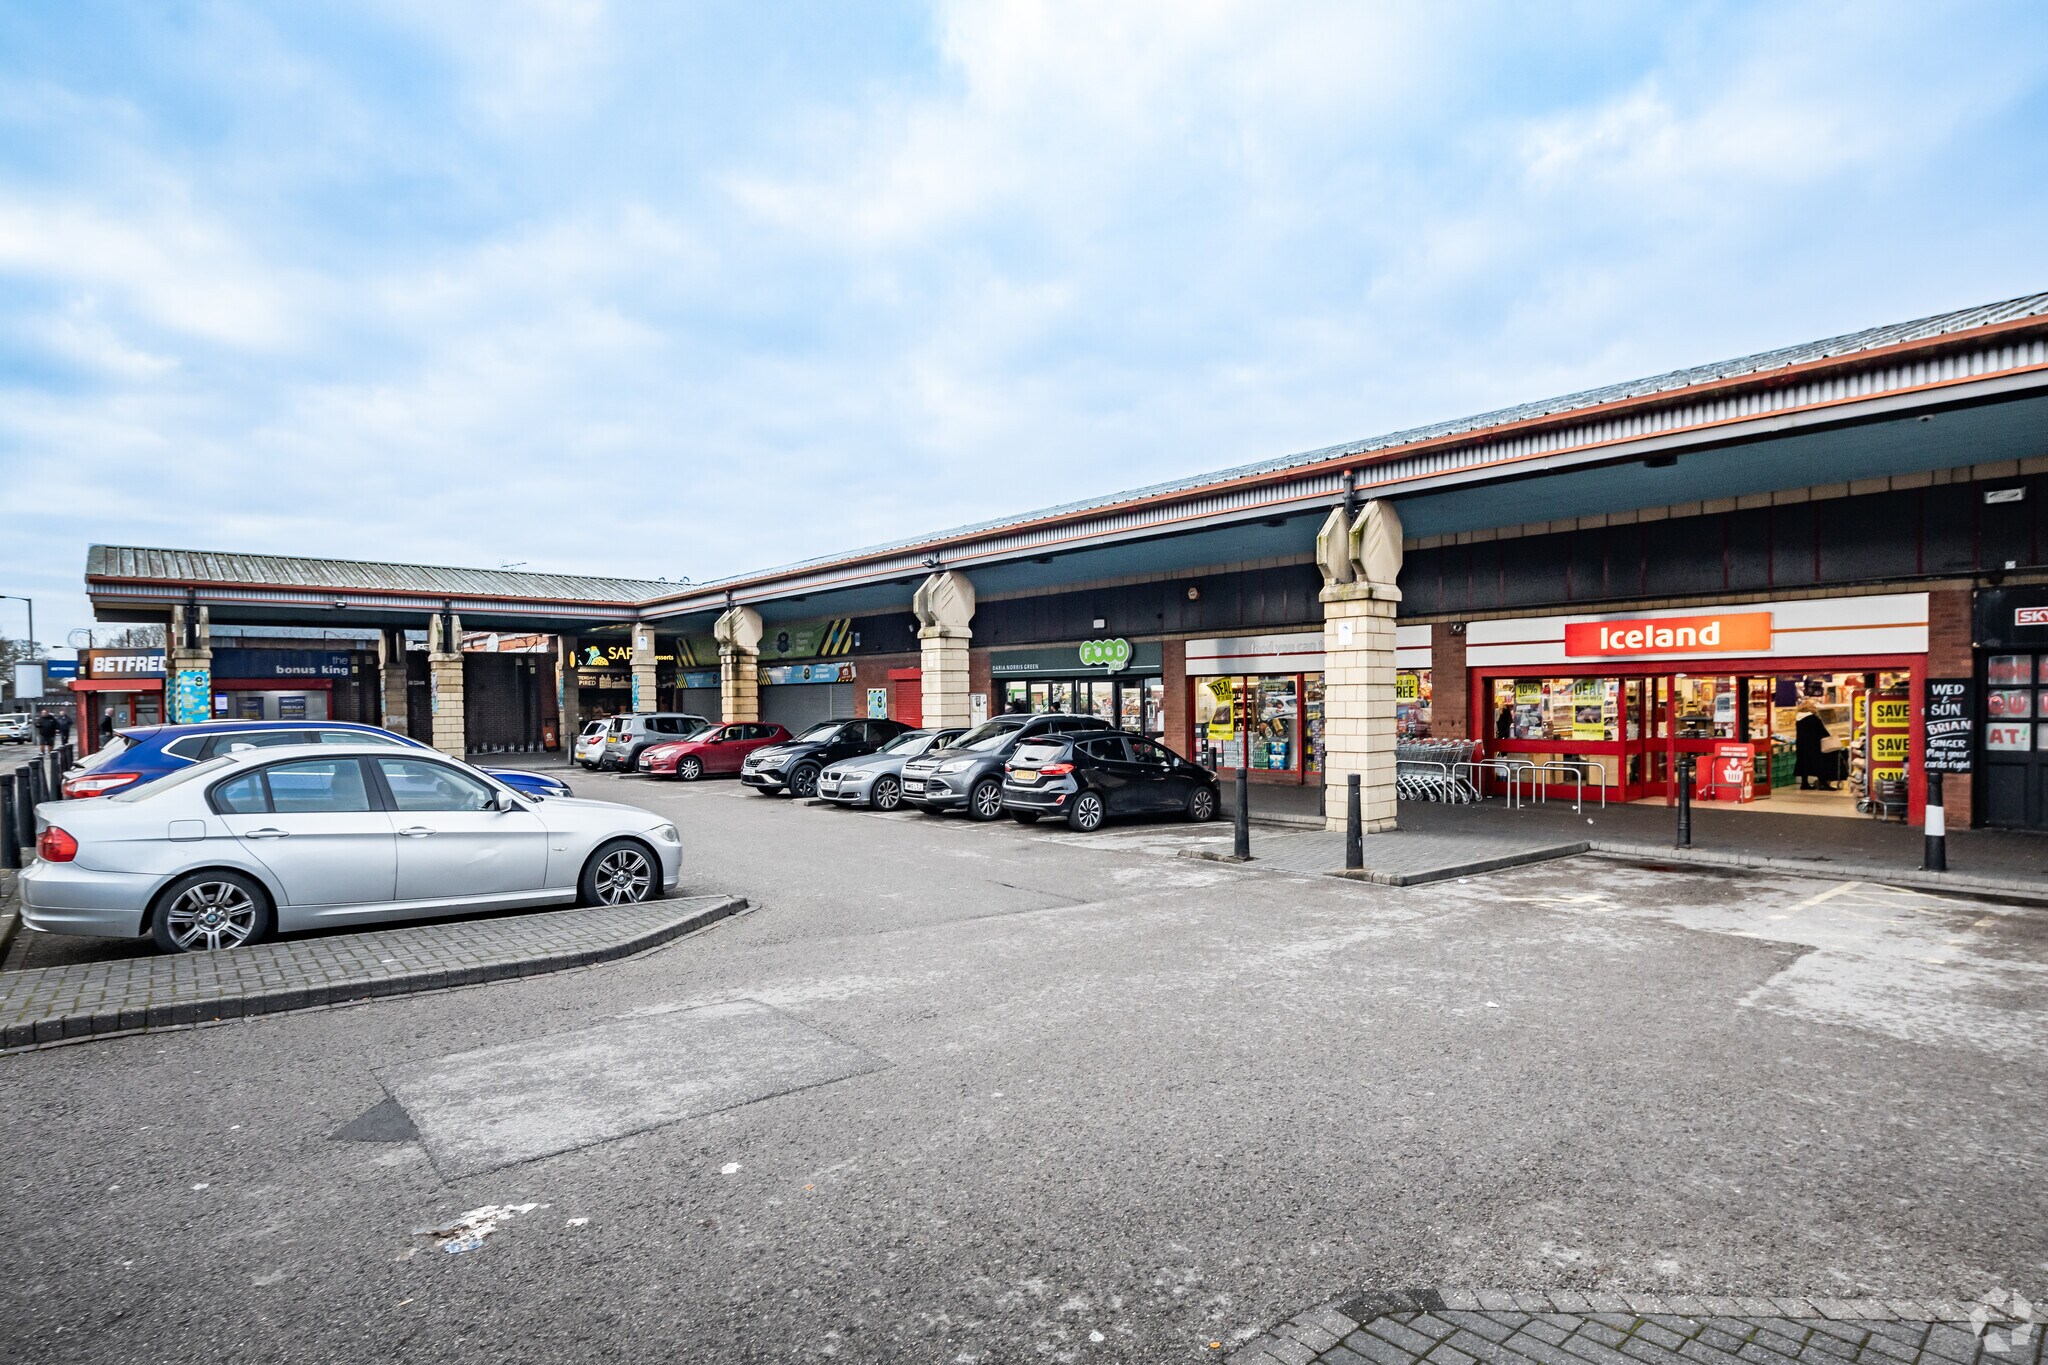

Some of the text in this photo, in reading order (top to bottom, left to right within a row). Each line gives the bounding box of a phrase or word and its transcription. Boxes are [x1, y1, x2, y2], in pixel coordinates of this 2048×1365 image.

[1600, 621, 1720, 649] Iceland
[608, 646, 633, 660] SAF
[1083, 647, 1126, 660] FOOD
[1251, 642, 1273, 654] food
[1274, 644, 1294, 656] you
[93, 656, 166, 672] BETFRED
[332, 656, 348, 664] the
[276, 665, 348, 676] bonus king
[1211, 680, 1232, 696] DEAL
[1394, 686, 1414, 698] REE
[1518, 684, 1538, 694] 10%
[1575, 682, 1602, 695] DEAL
[1932, 684, 1965, 695] WED
[1877, 705, 1909, 717] SAVE
[1931, 703, 1961, 716] SUN
[1927, 720, 1971, 735] BRIAN
[1877, 738, 1909, 750] SAVE
[1930, 740, 1966, 748] SINGER
[1947, 751, 1970, 760] your
[1948, 761, 1971, 772] right
[1878, 772, 1903, 780] SAV
